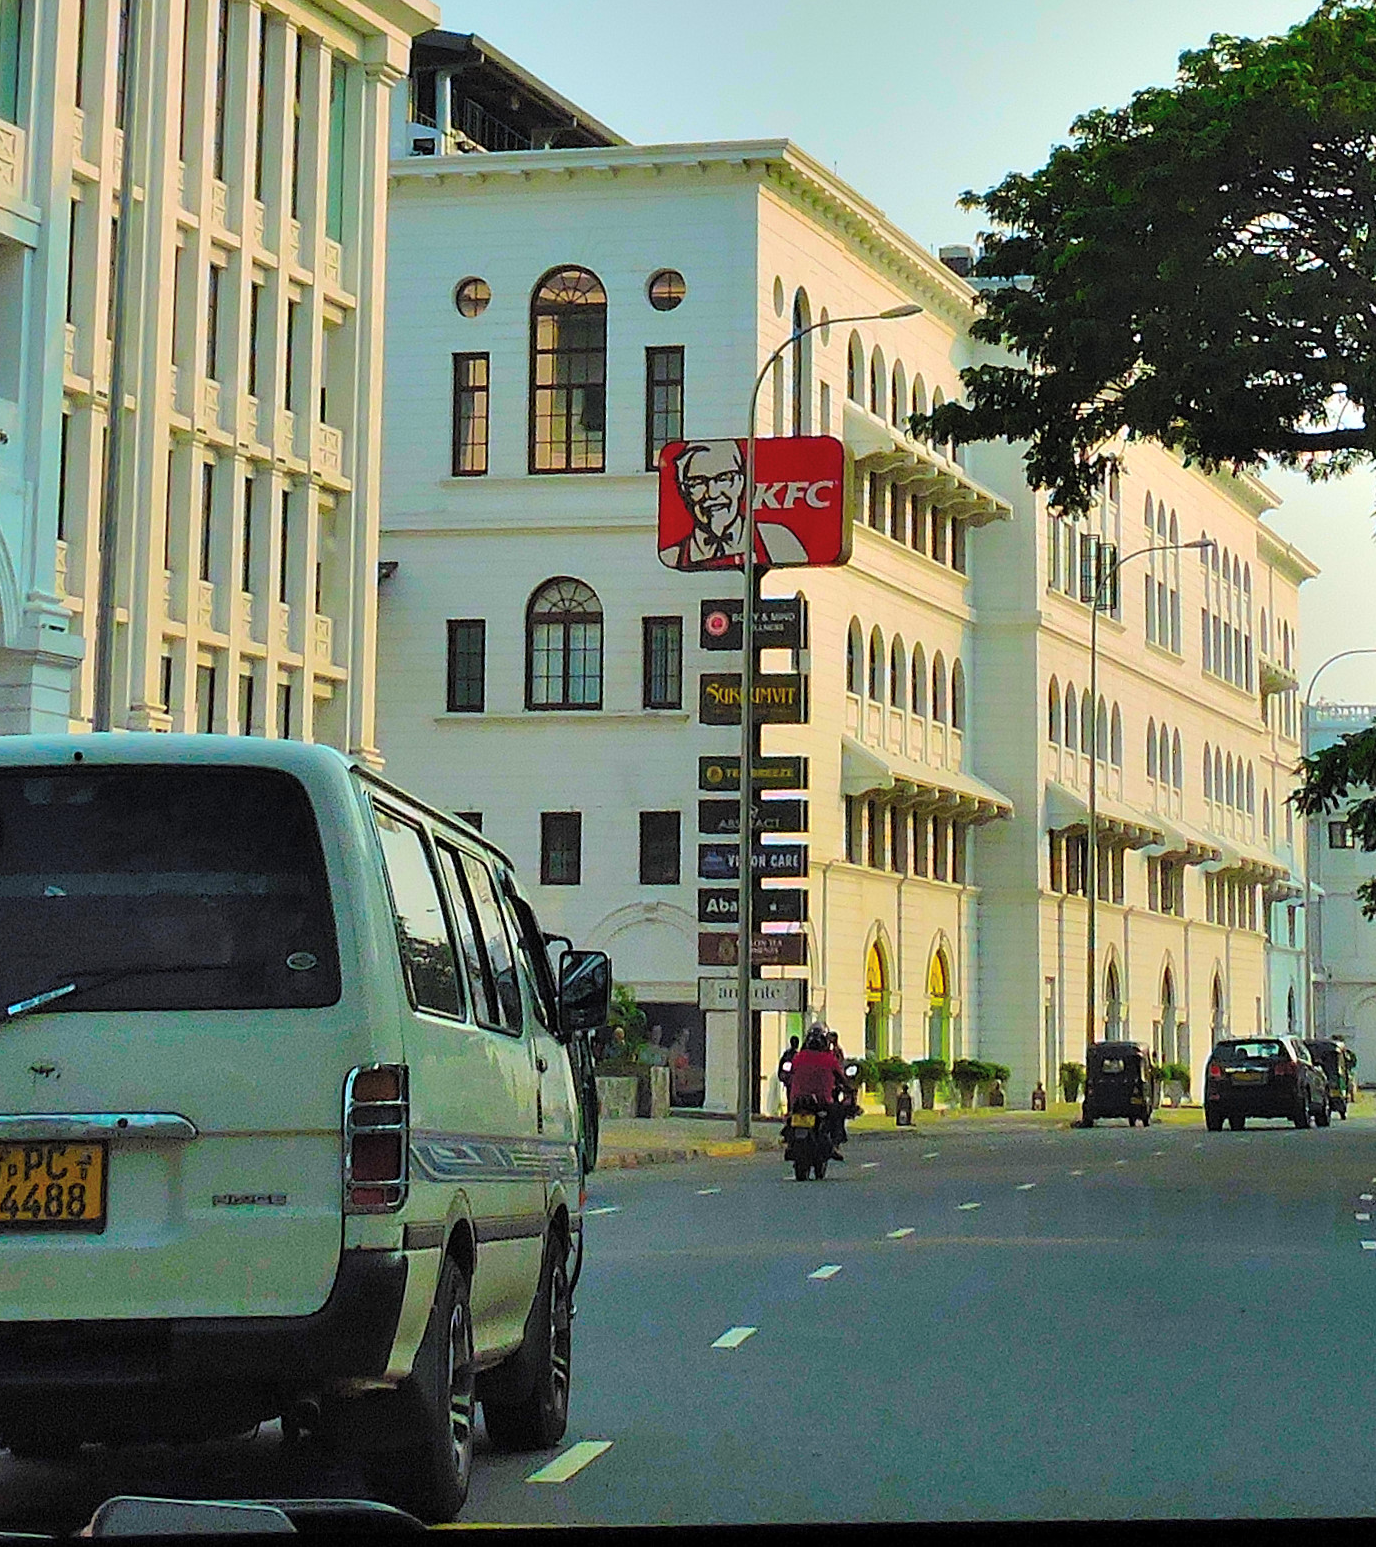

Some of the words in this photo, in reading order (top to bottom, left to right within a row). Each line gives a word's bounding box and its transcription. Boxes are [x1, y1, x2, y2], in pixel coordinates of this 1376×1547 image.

[752, 480, 834, 510] KFC
[731, 613, 759, 622] BOY
[706, 683, 796, 705] SUKUMVIT
[728, 854, 766, 868] VION
[770, 854, 799, 868] CARE
[24, 1144, 68, 1181] PC
[0, 1182, 86, 1219] 4488
